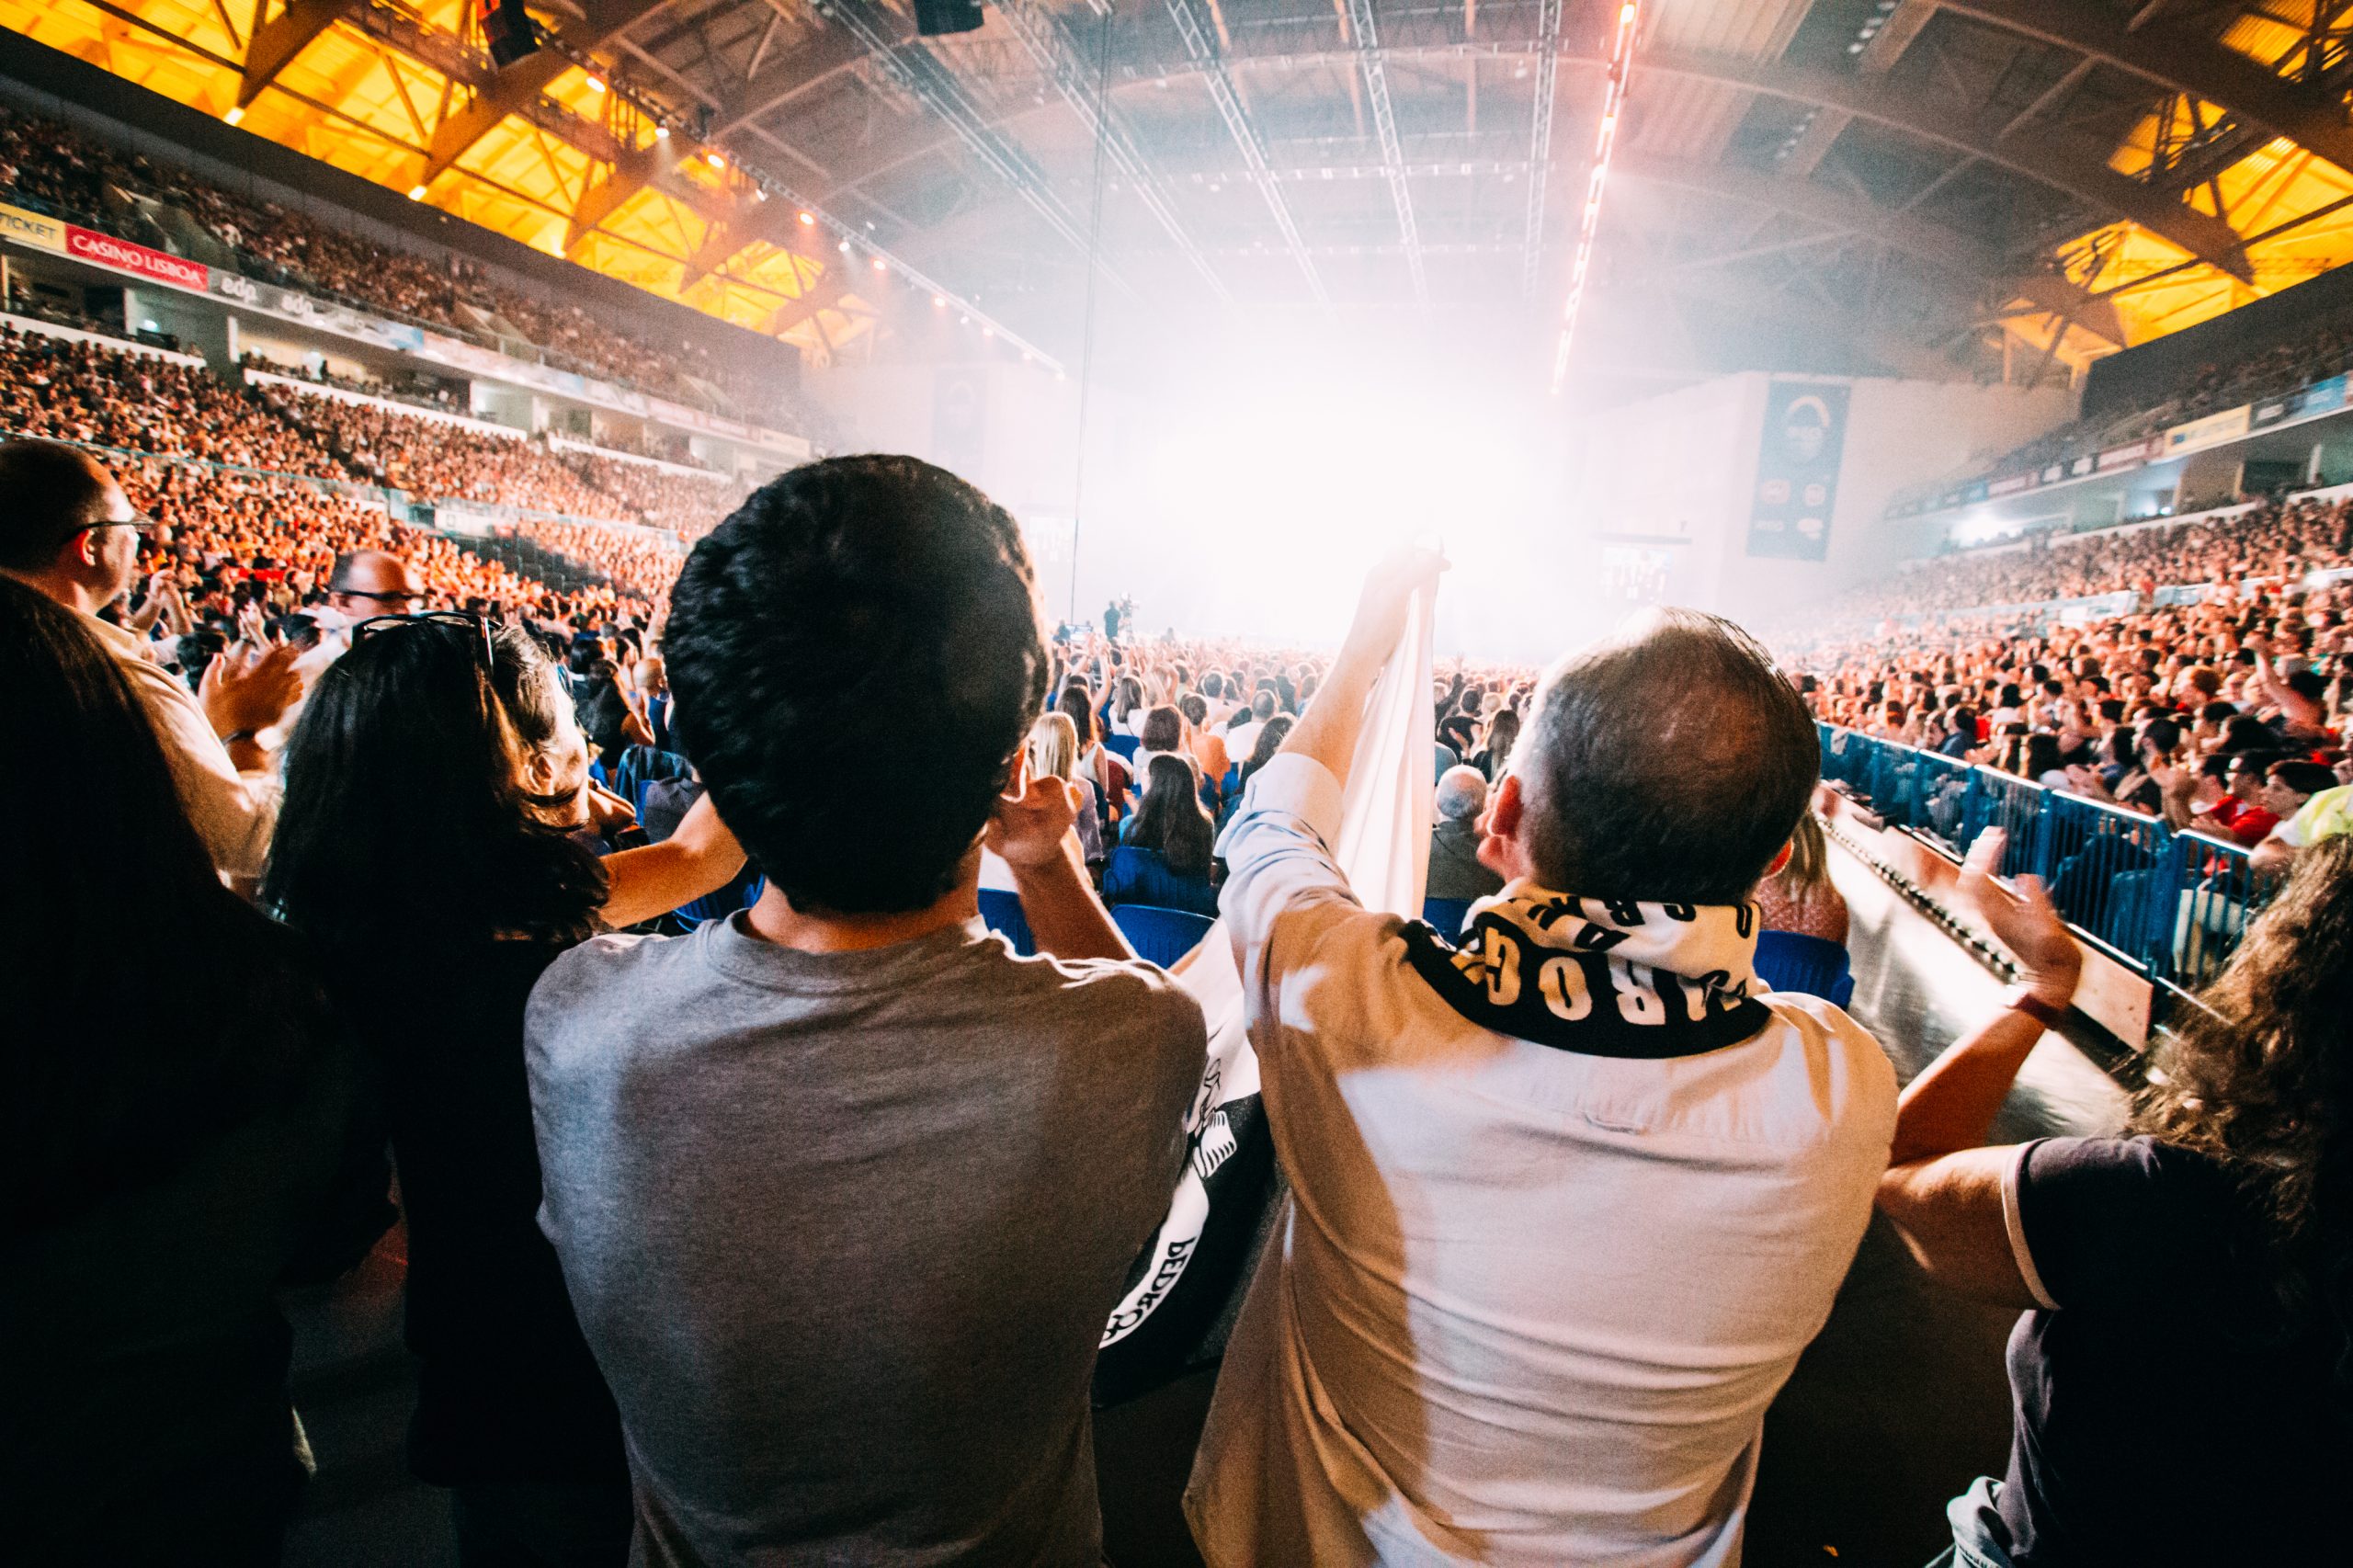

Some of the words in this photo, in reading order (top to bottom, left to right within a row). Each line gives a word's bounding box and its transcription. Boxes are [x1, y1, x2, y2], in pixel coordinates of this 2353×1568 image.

[73, 235, 142, 267] CASINO
[145, 255, 202, 286] LISBOA
[221, 277, 257, 303] edp
